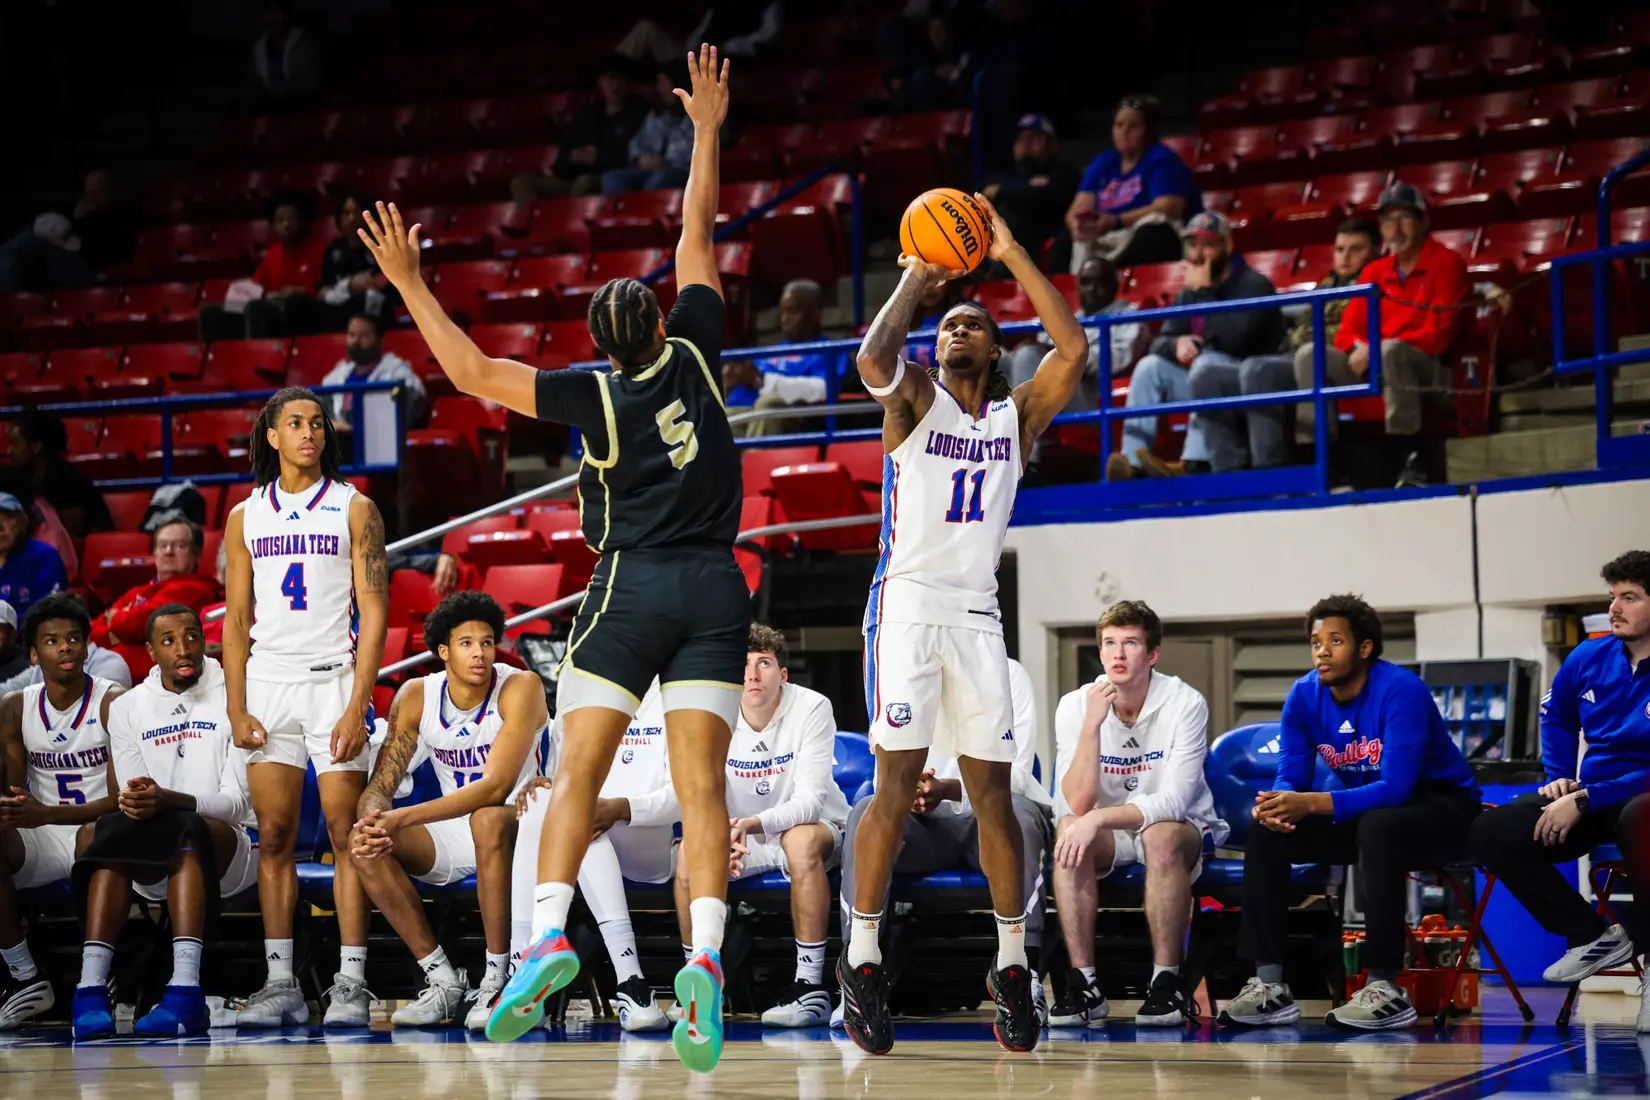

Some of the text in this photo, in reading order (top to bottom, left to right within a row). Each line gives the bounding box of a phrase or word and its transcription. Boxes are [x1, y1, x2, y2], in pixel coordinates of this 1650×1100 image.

[941, 200, 978, 257] Wilson
[655, 397, 699, 470] 5
[925, 430, 1011, 463] LOUISIAA TECH
[945, 468, 986, 523] 11
[251, 534, 339, 559] LOUISIANA TECH
[281, 562, 307, 611] 4
[192, 721, 217, 731] TECH
[78, 745, 108, 768] TECH
[727, 759, 772, 769] OUISIANA
[1100, 751, 1164, 766] OUISIANA TCH
[1317, 736, 1383, 769] Bulldg
[55, 774, 86, 805] 5
